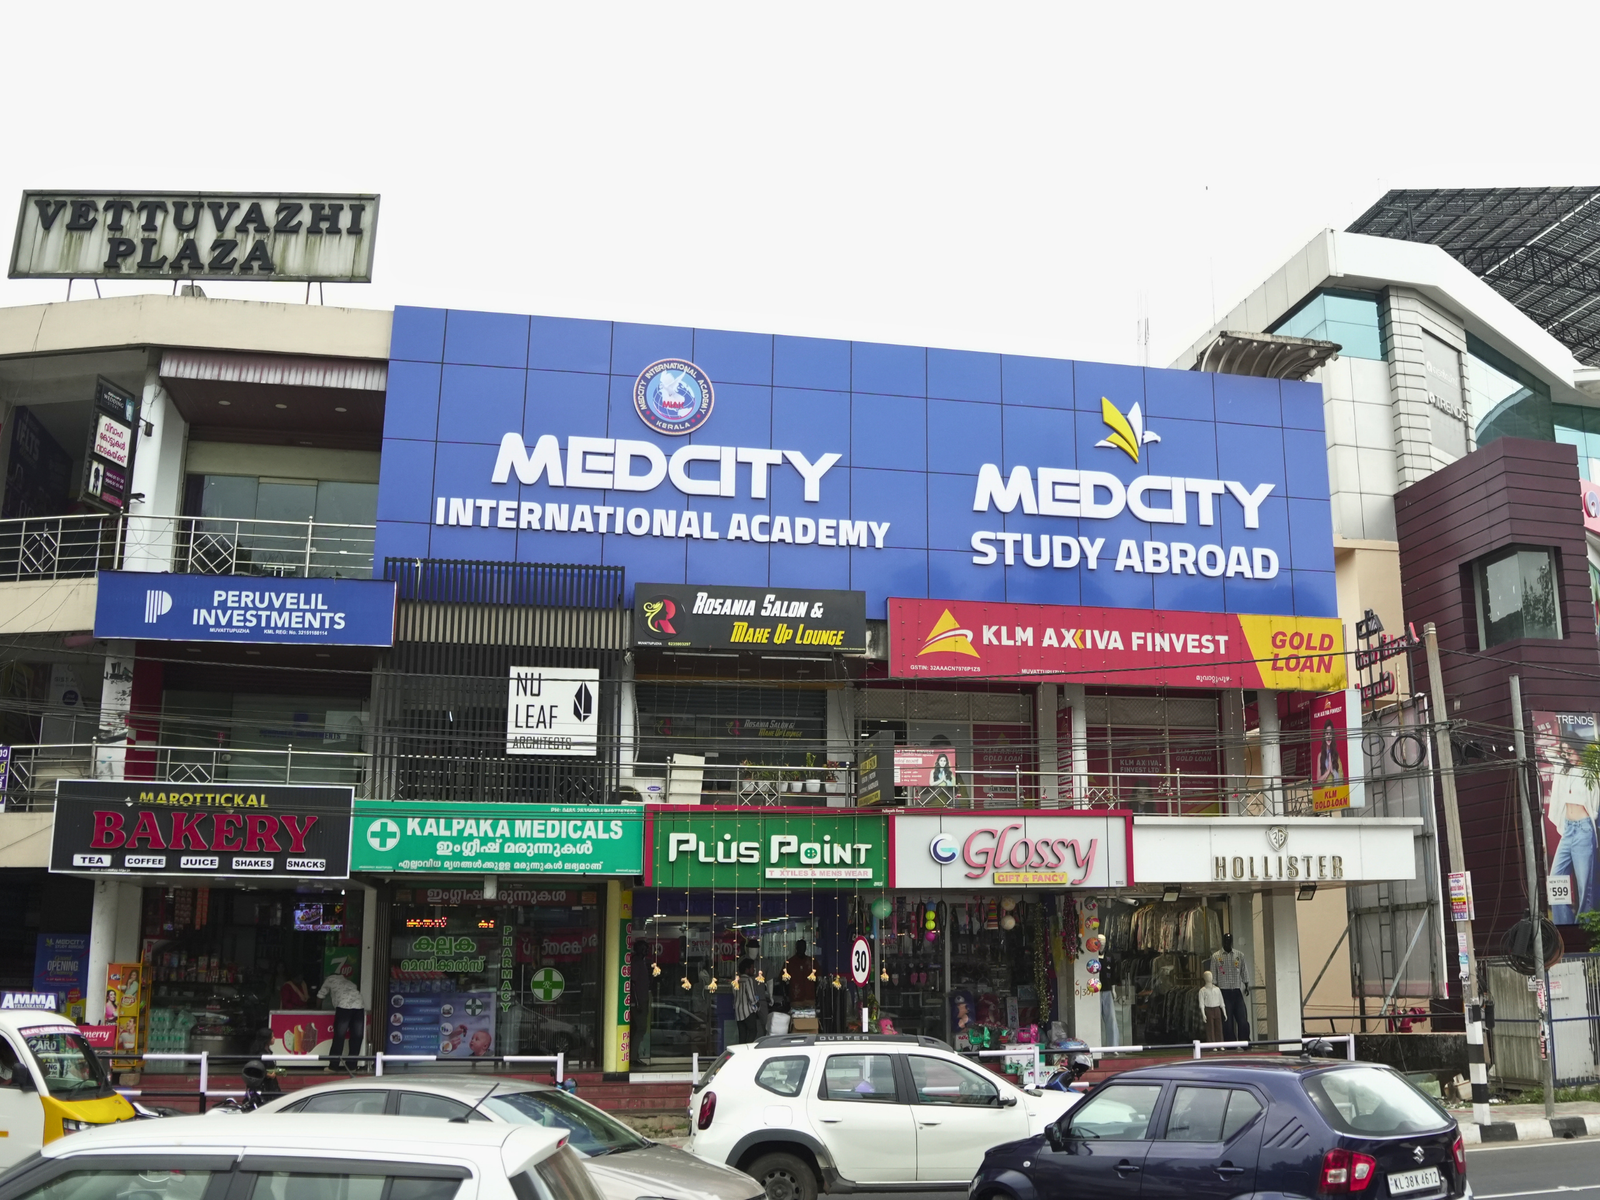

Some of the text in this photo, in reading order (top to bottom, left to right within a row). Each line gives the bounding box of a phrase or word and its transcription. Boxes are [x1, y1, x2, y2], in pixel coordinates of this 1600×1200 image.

[35, 199, 366, 235] VETTUVAZHI
[104, 237, 275, 271] PLAZA
[645, 362, 697, 379] INTERNATIONAL
[637, 380, 647, 410] MEDCITY
[698, 379, 710, 415] ACADEMY
[1434, 394, 1467, 421] TRENDS
[656, 420, 690, 430] KERALA
[491, 432, 842, 502] MEDCITY
[972, 463, 1276, 529] MEDCITY
[435, 497, 890, 548] INTERNATIONAL ACADEMY
[970, 530, 1279, 580] STUDY ABROAD
[213, 590, 328, 610] PERUVELIL
[692, 592, 824, 618] ROSANIA SALON &
[192, 608, 346, 629] INVESTMENTS
[730, 621, 845, 646] MAKE UP LOUNGE
[982, 624, 1033, 647] KLM
[1131, 632, 1229, 655] FINVEST
[1271, 630, 1334, 652] GOLD
[1271, 653, 1333, 674] LOAN
[516, 672, 541, 697] NU
[515, 704, 558, 729] LEAF
[1556, 715, 1594, 726] TRENDS
[139, 792, 269, 808] MAROTTICKAL
[1314, 797, 1348, 809] GOLD LOAN
[1324, 790, 1337, 799] KLM
[90, 810, 318, 853] BAKERY
[407, 817, 623, 840] KALPAKA MEDICALS
[80, 856, 325, 869] TEA COFFEE JUICE SHAKES SNACKS
[963, 823, 1098, 885] Glossy
[997, 874, 1065, 883] GIFT & FANCY
[1213, 855, 1343, 880] HOLLISTER
[47, 960, 79, 971] OPENING
[501, 925, 513, 1013] PHARMACY
[854, 950, 867, 972] 30
[1, 993, 56, 1009] AMMA
[1393, 1177, 1404, 1190] KL
[1421, 1171, 1438, 1185] 4612
